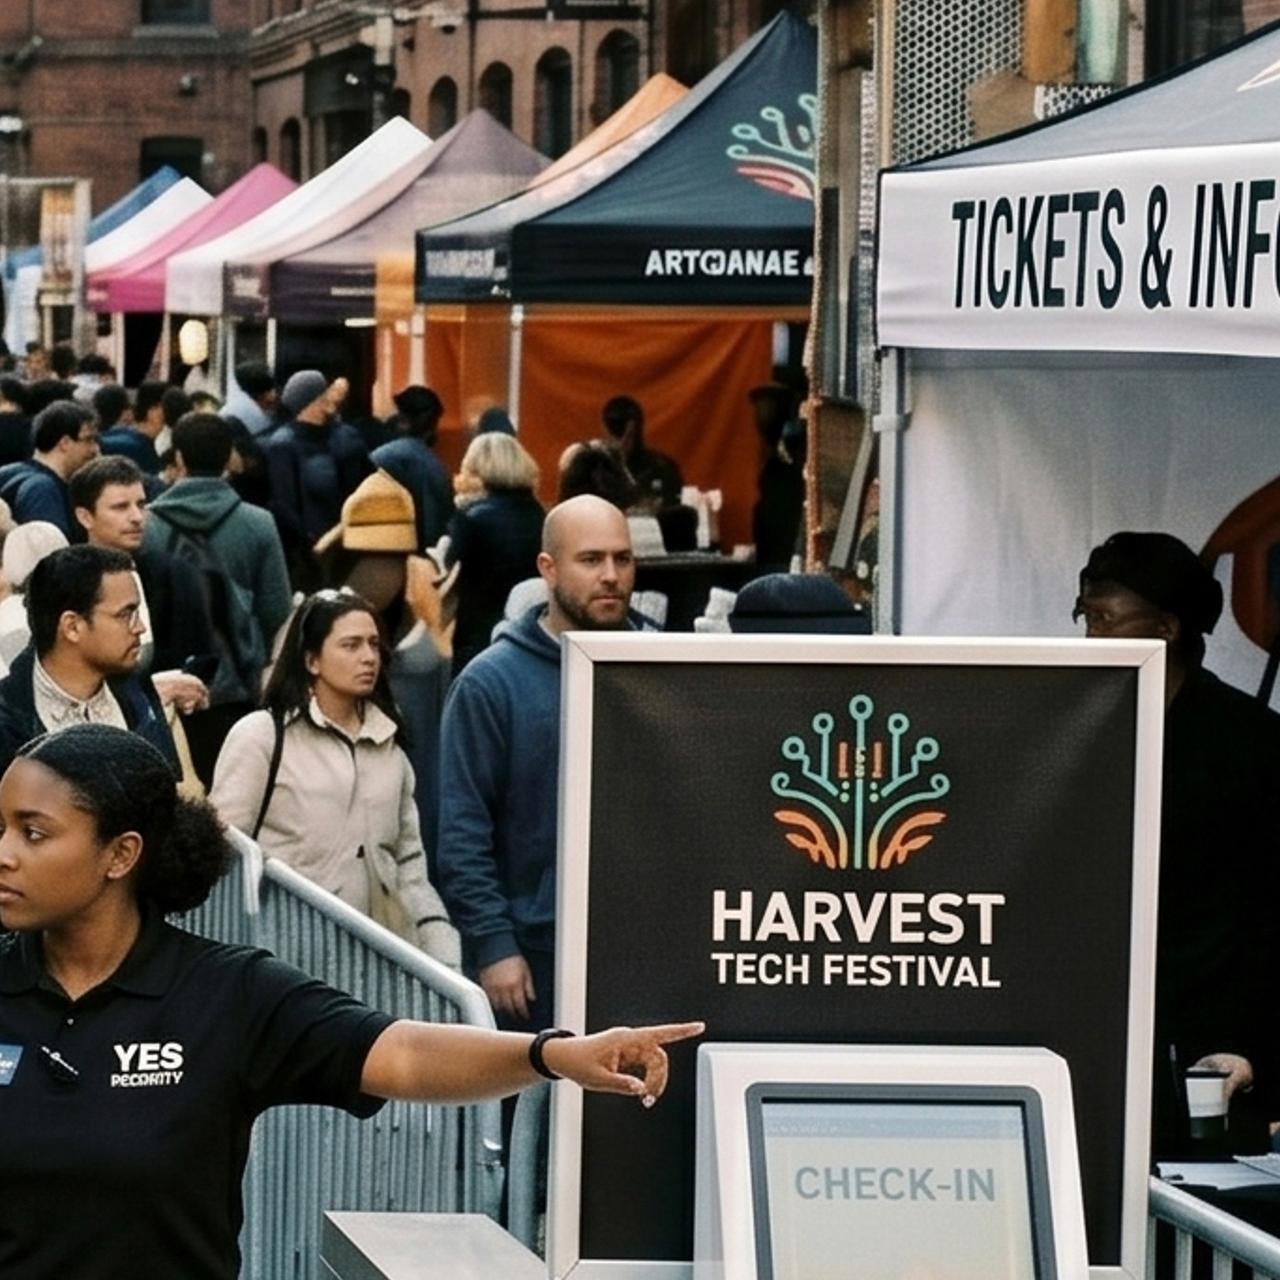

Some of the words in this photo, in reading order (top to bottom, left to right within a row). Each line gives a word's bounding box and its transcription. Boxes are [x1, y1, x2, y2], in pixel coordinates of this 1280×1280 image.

[951, 188, 1126, 310] TICKETS
[1140, 184, 1173, 310] &
[1188, 179, 1280, 309] INF
[712, 889, 1006, 946] HARVEST
[710, 952, 810, 986] TECH
[823, 954, 1002, 988] FESTIVAL
[113, 1042, 184, 1072] YES
[795, 1166, 995, 1202] CHECK-IN
